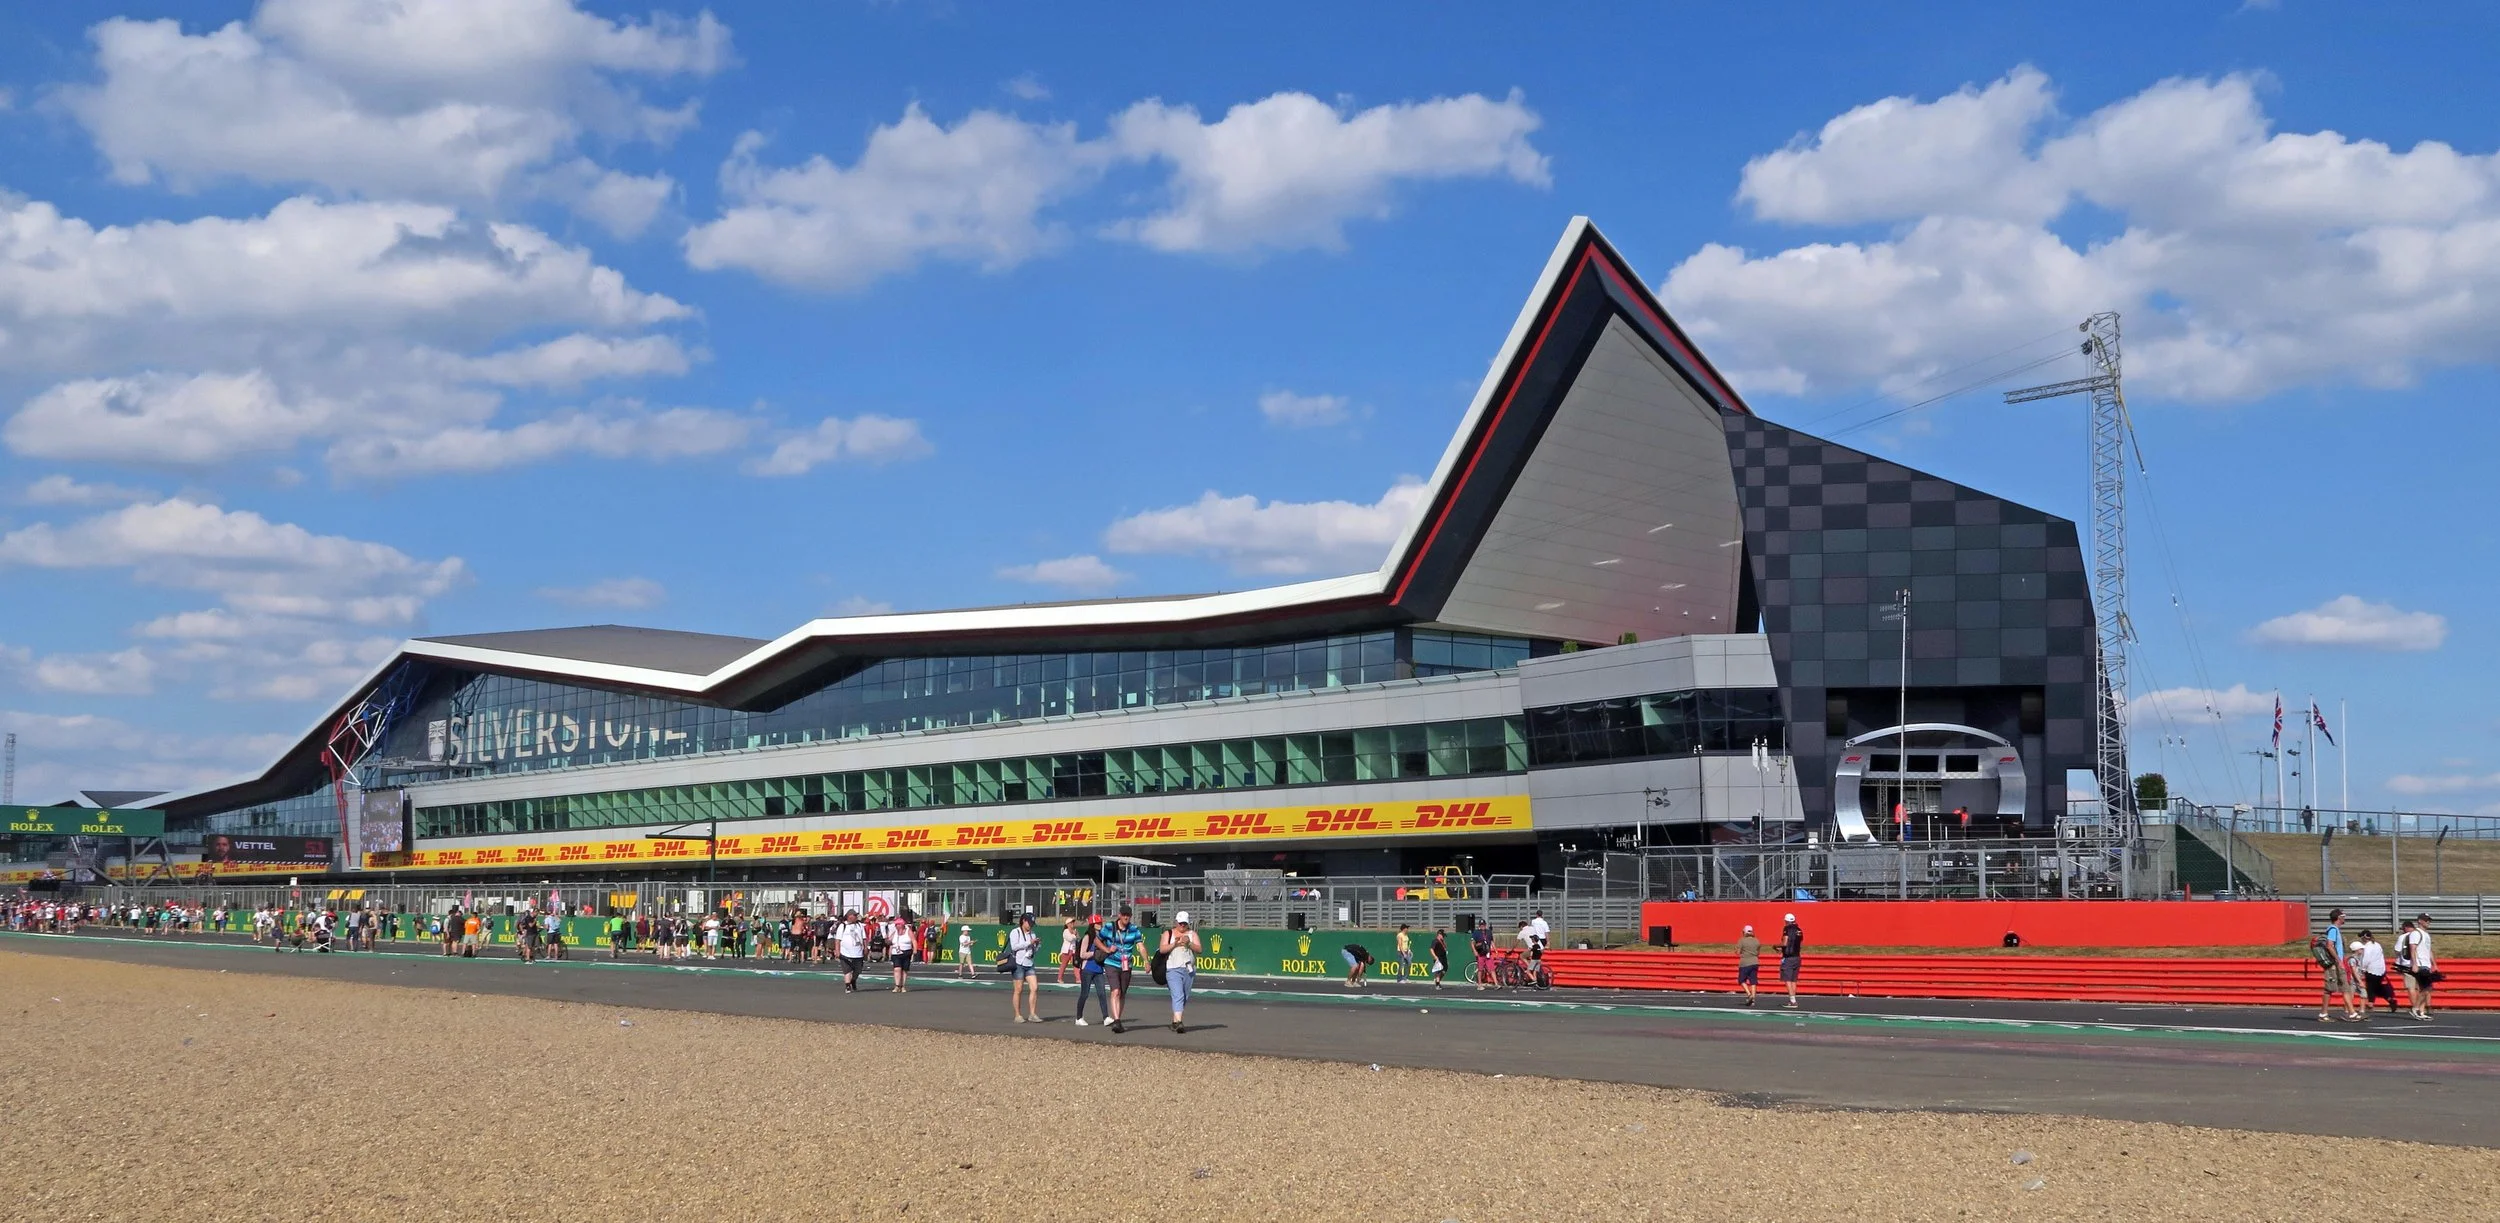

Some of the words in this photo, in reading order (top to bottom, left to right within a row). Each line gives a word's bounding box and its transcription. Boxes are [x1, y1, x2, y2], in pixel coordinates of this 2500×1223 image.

[1305, 808, 1379, 832] DHL
[1414, 802, 1497, 828] DHL
[10, 822, 54, 832] ROLEX
[81, 824, 124, 833] ROLEX
[1115, 817, 1175, 839] DHL
[1206, 813, 1272, 836] DHL
[886, 829, 933, 848] DHL
[956, 826, 1007, 845] DHL
[1032, 822, 1088, 842] DHL
[235, 841, 277, 850] VETTEL
[705, 838, 743, 855] DHL
[761, 836, 801, 853] DHL
[822, 832, 865, 851] DHL
[516, 848, 546, 862] DHL
[560, 846, 591, 860] DHL
[605, 844, 638, 858] DHL
[653, 841, 688, 857] DHL
[402, 853, 427, 866] DHL
[438, 852, 464, 865] DHL
[476, 850, 504, 863] DHL
[986, 868, 994, 877] 05
[1060, 867, 1068, 876] 04
[596, 936, 611, 945] ROLE
[1196, 957, 1236, 971] ROLEX
[1282, 959, 1327, 974] ROLEX
